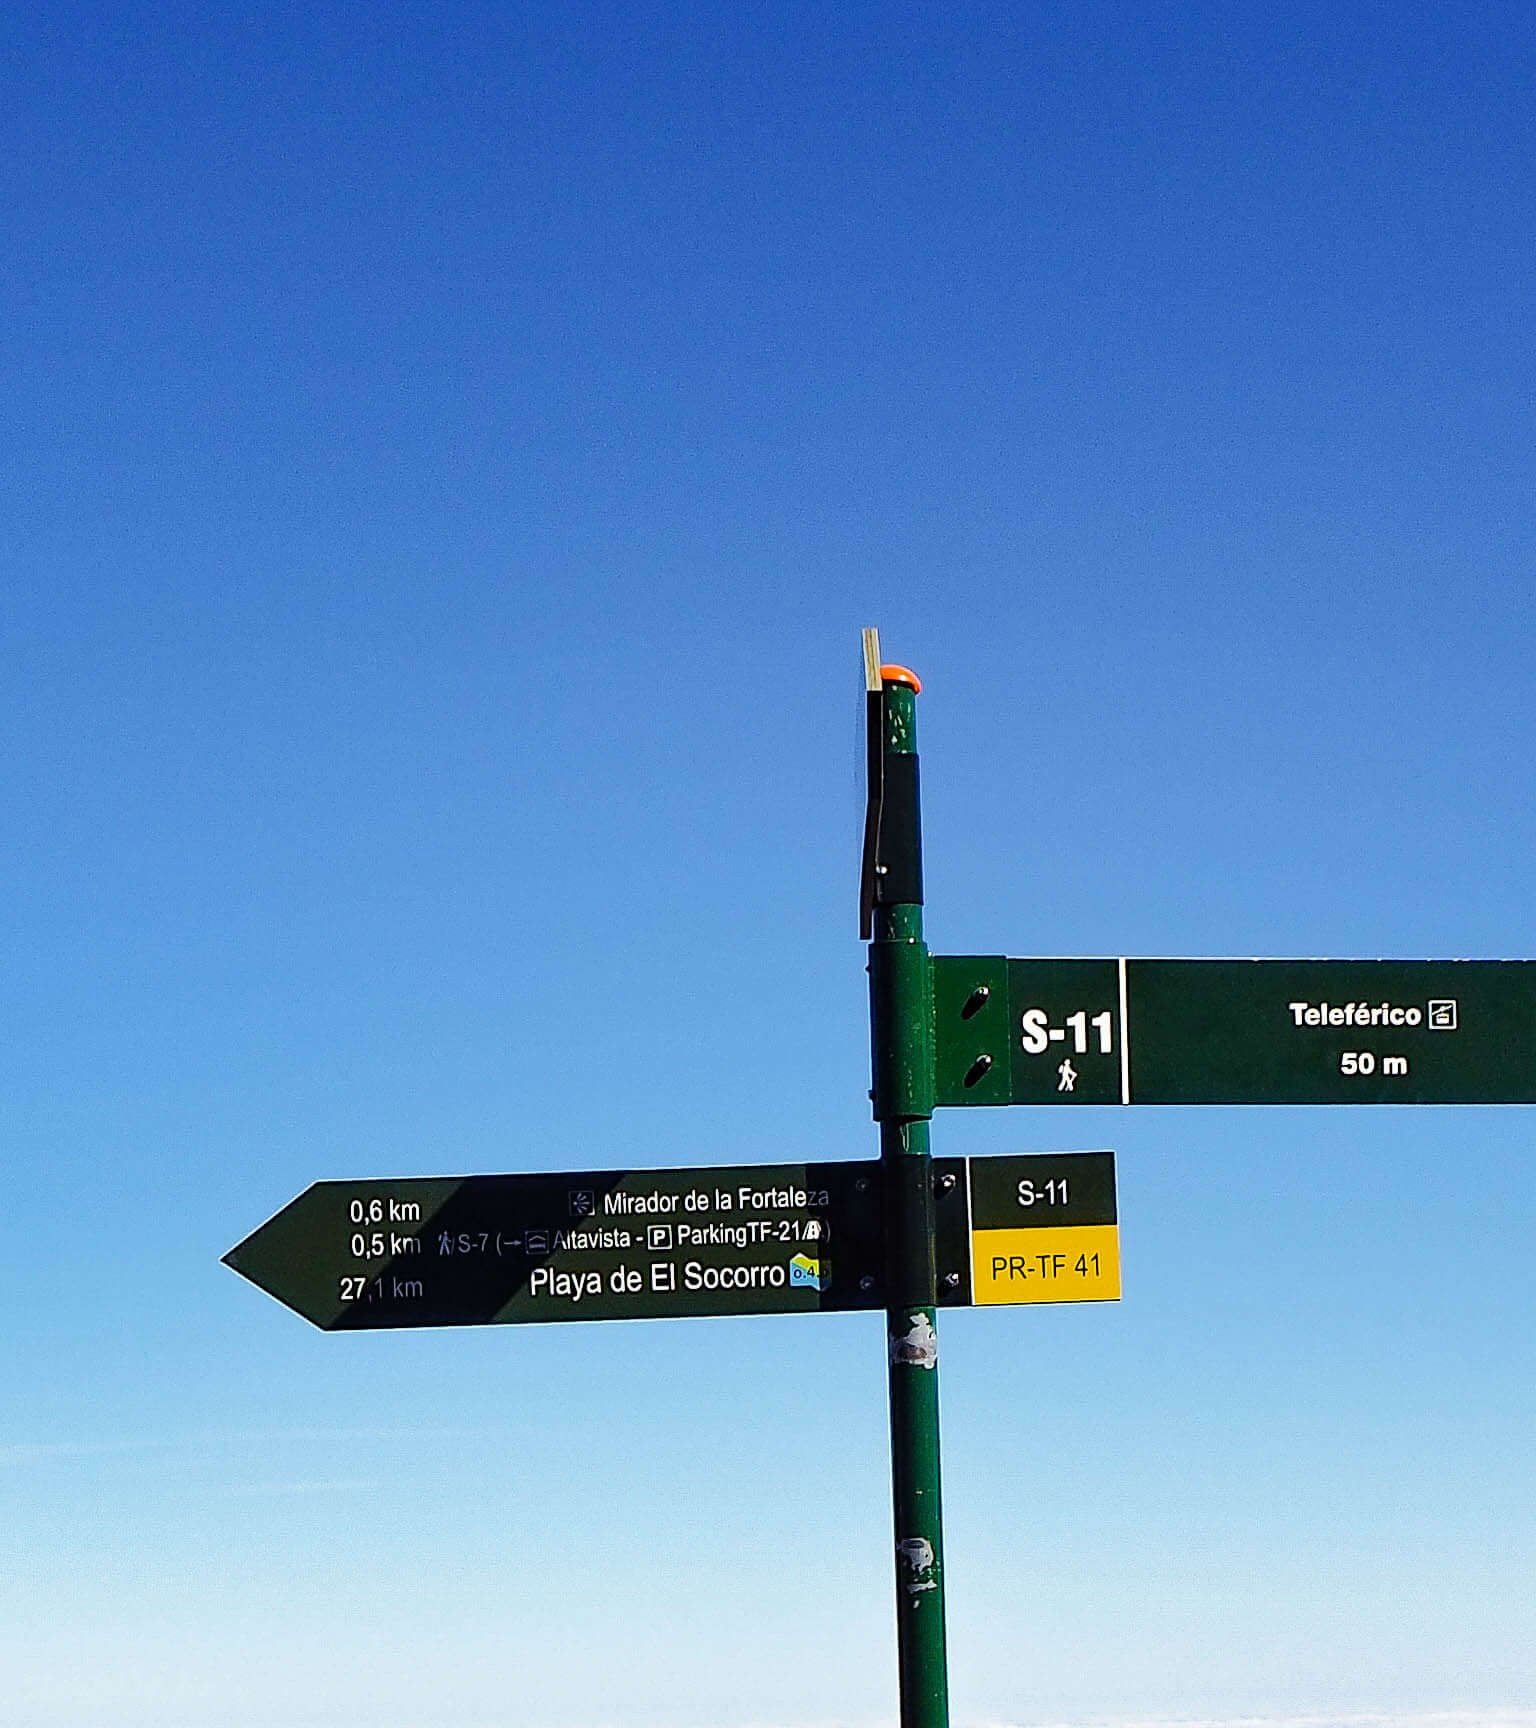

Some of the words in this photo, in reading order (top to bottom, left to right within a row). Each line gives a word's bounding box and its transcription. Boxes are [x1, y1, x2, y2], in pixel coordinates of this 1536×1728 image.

[1288, 1002, 1422, 1026] Teleférico
[1022, 1009, 1112, 1054] S-11
[1340, 1052, 1375, 1075] 50
[1383, 1056, 1408, 1075] m
[604, 1190, 680, 1215] Mirador
[684, 1189, 709, 1212] de
[715, 1188, 732, 1211] la
[738, 1185, 829, 1210] Fortaleza
[1018, 1179, 1068, 1206] S-11
[350, 1199, 383, 1226] 0,6
[389, 1199, 420, 1222] km
[351, 1233, 385, 1260] 0,5
[390, 1232, 421, 1255] km
[458, 1233, 489, 1253] S-7
[553, 1227, 631, 1250] Altavista
[992, 1254, 1066, 1280] PR-TF
[1074, 1253, 1100, 1277] 41
[339, 1277, 383, 1303] 27,1
[393, 1276, 423, 1299] km
[530, 1267, 602, 1302] Playa
[610, 1264, 643, 1293] de
[651, 1262, 676, 1291] El
[684, 1261, 785, 1290] Socorro
